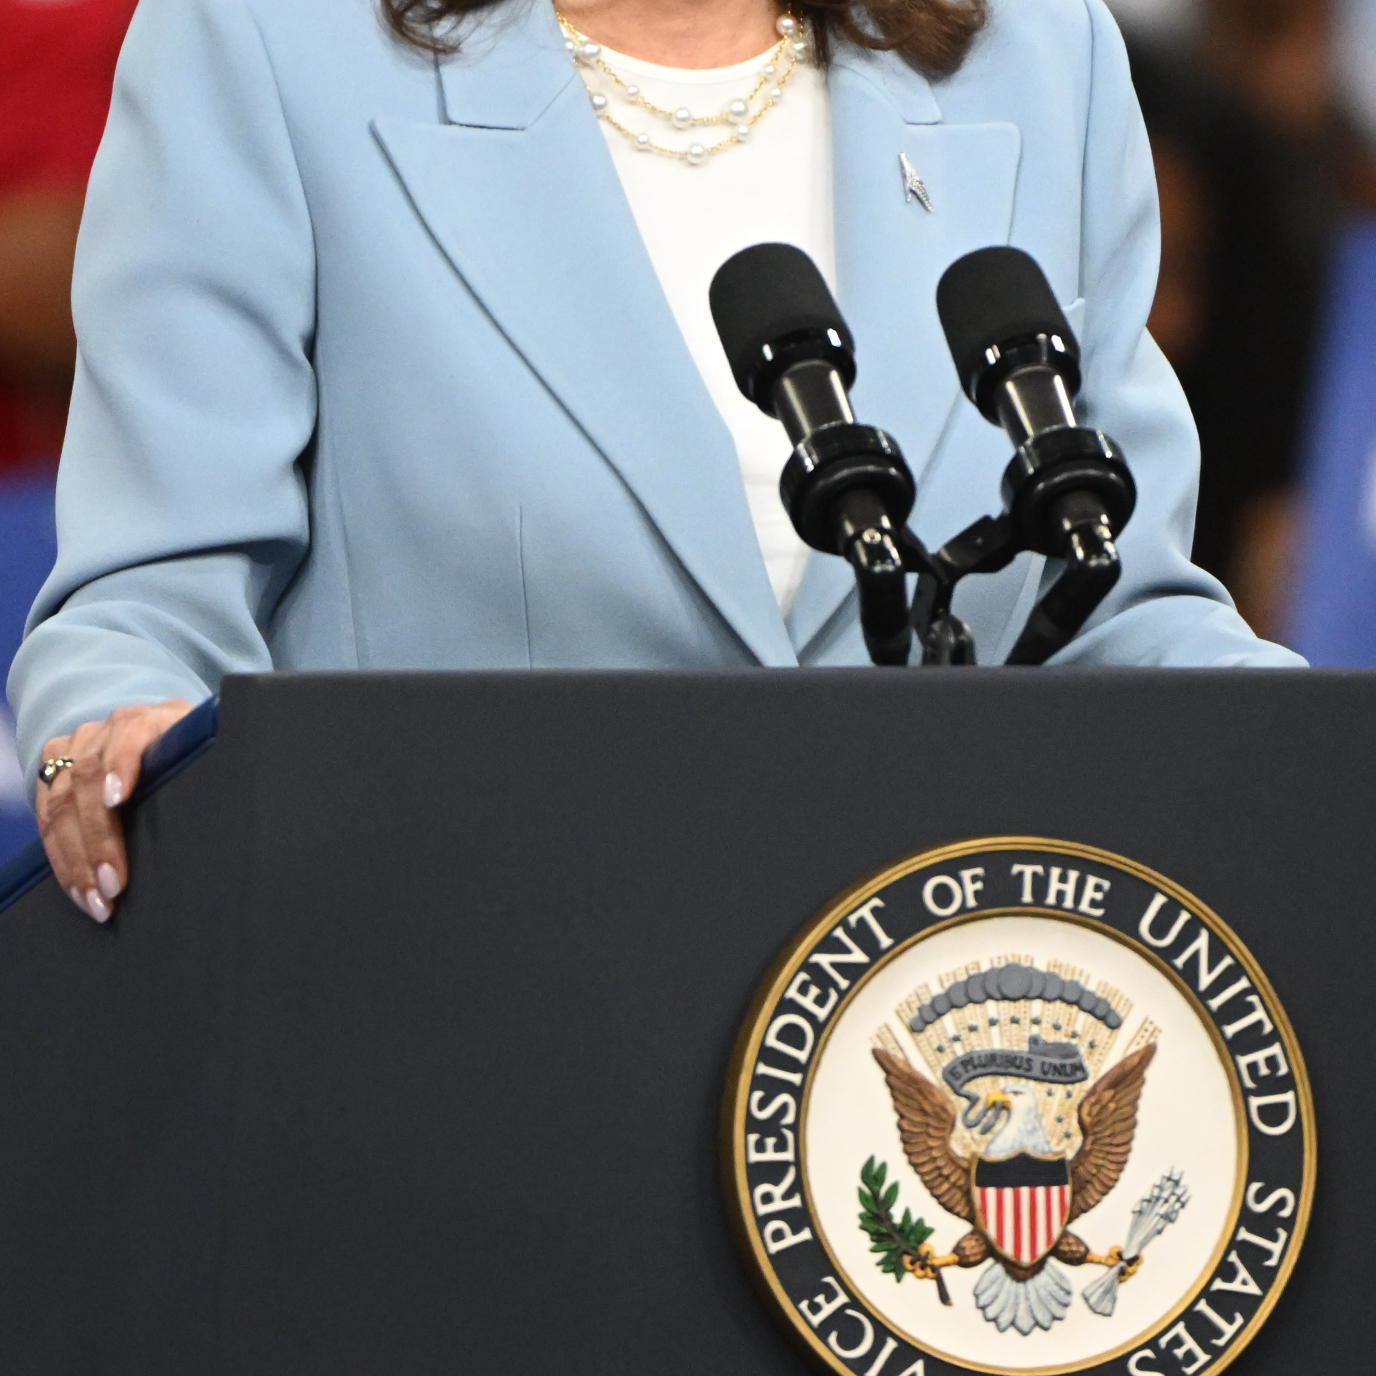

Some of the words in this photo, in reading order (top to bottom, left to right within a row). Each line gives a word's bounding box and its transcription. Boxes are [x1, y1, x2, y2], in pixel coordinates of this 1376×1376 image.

[746, 896, 895, 1256] PRESIDENT
[921, 864, 985, 918] OF
[1010, 863, 1112, 918] THE
[1138, 892, 1298, 1138] UNITED
